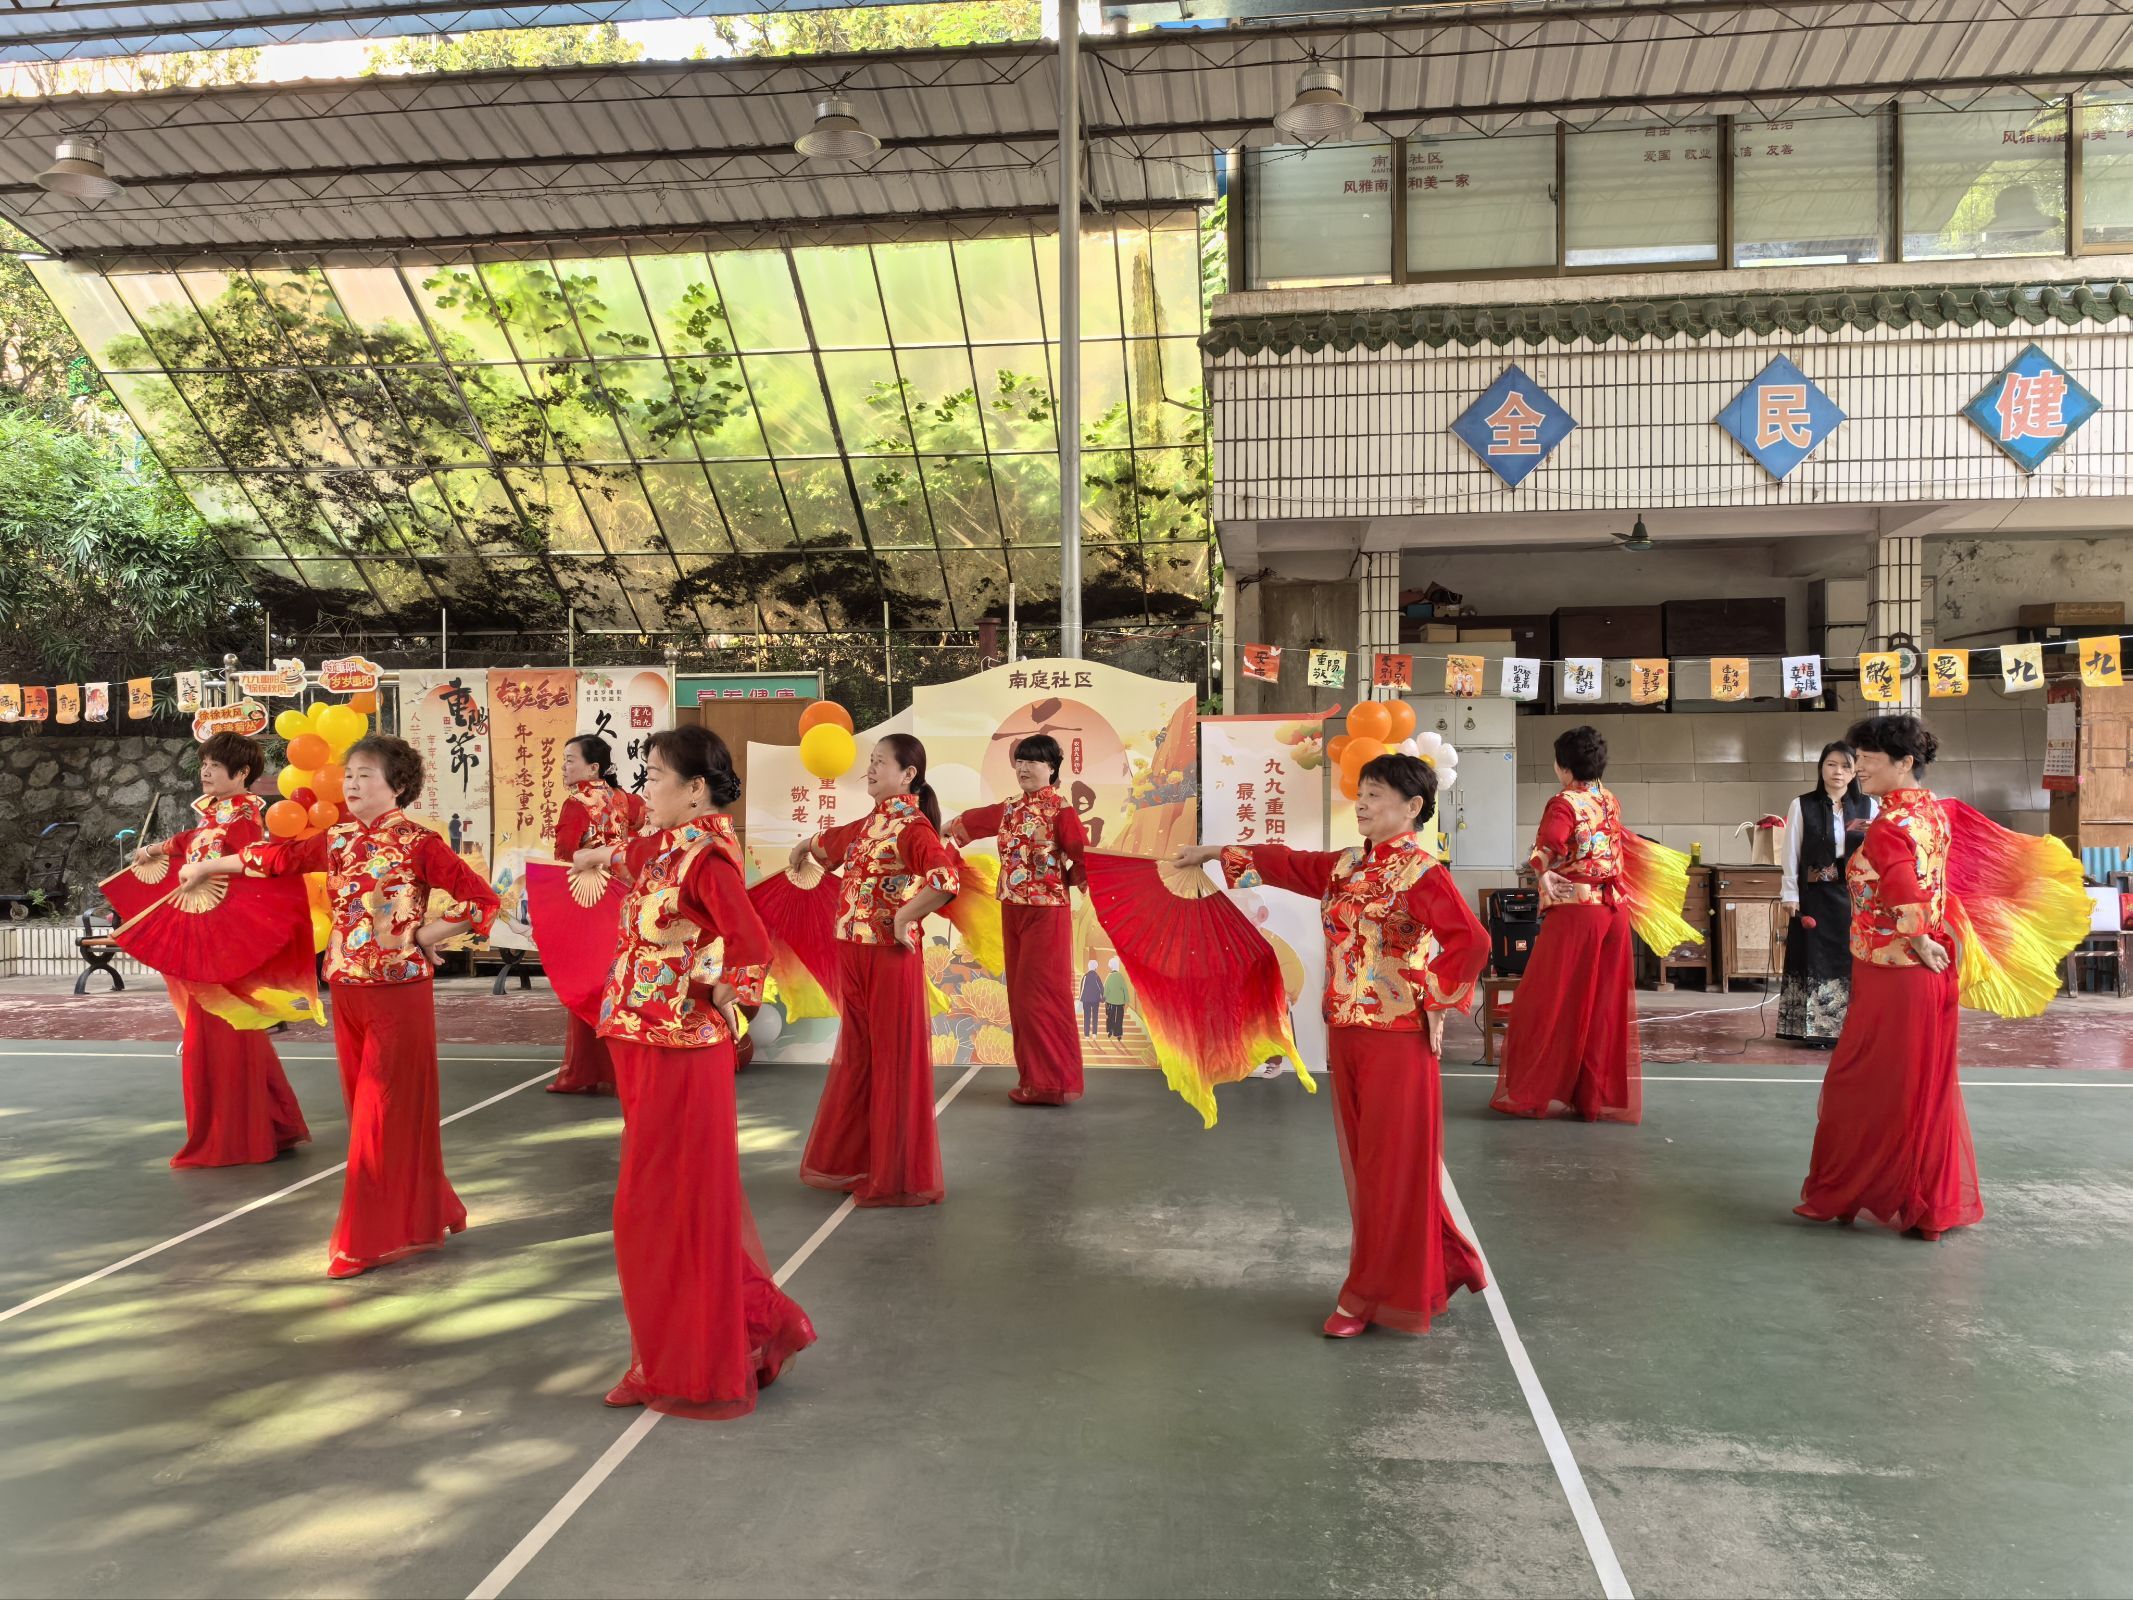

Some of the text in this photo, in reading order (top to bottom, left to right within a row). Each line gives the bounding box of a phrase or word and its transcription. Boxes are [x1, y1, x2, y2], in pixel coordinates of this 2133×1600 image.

[1370, 151, 1443, 168] 南社区
[1343, 173, 1470, 194] 风雅南和美一家
[1484, 369, 2068, 456] 全 民 健
[2006, 658, 2038, 682] 九
[2086, 651, 2117, 675] 九
[1008, 669, 1094, 690] 南庭社区
[1866, 660, 1893, 697] 敬老
[595, 709, 618, 738] 久
[514, 722, 535, 831] 年年逢重阳
[540, 737, 557, 840] 岁岁皆安康
